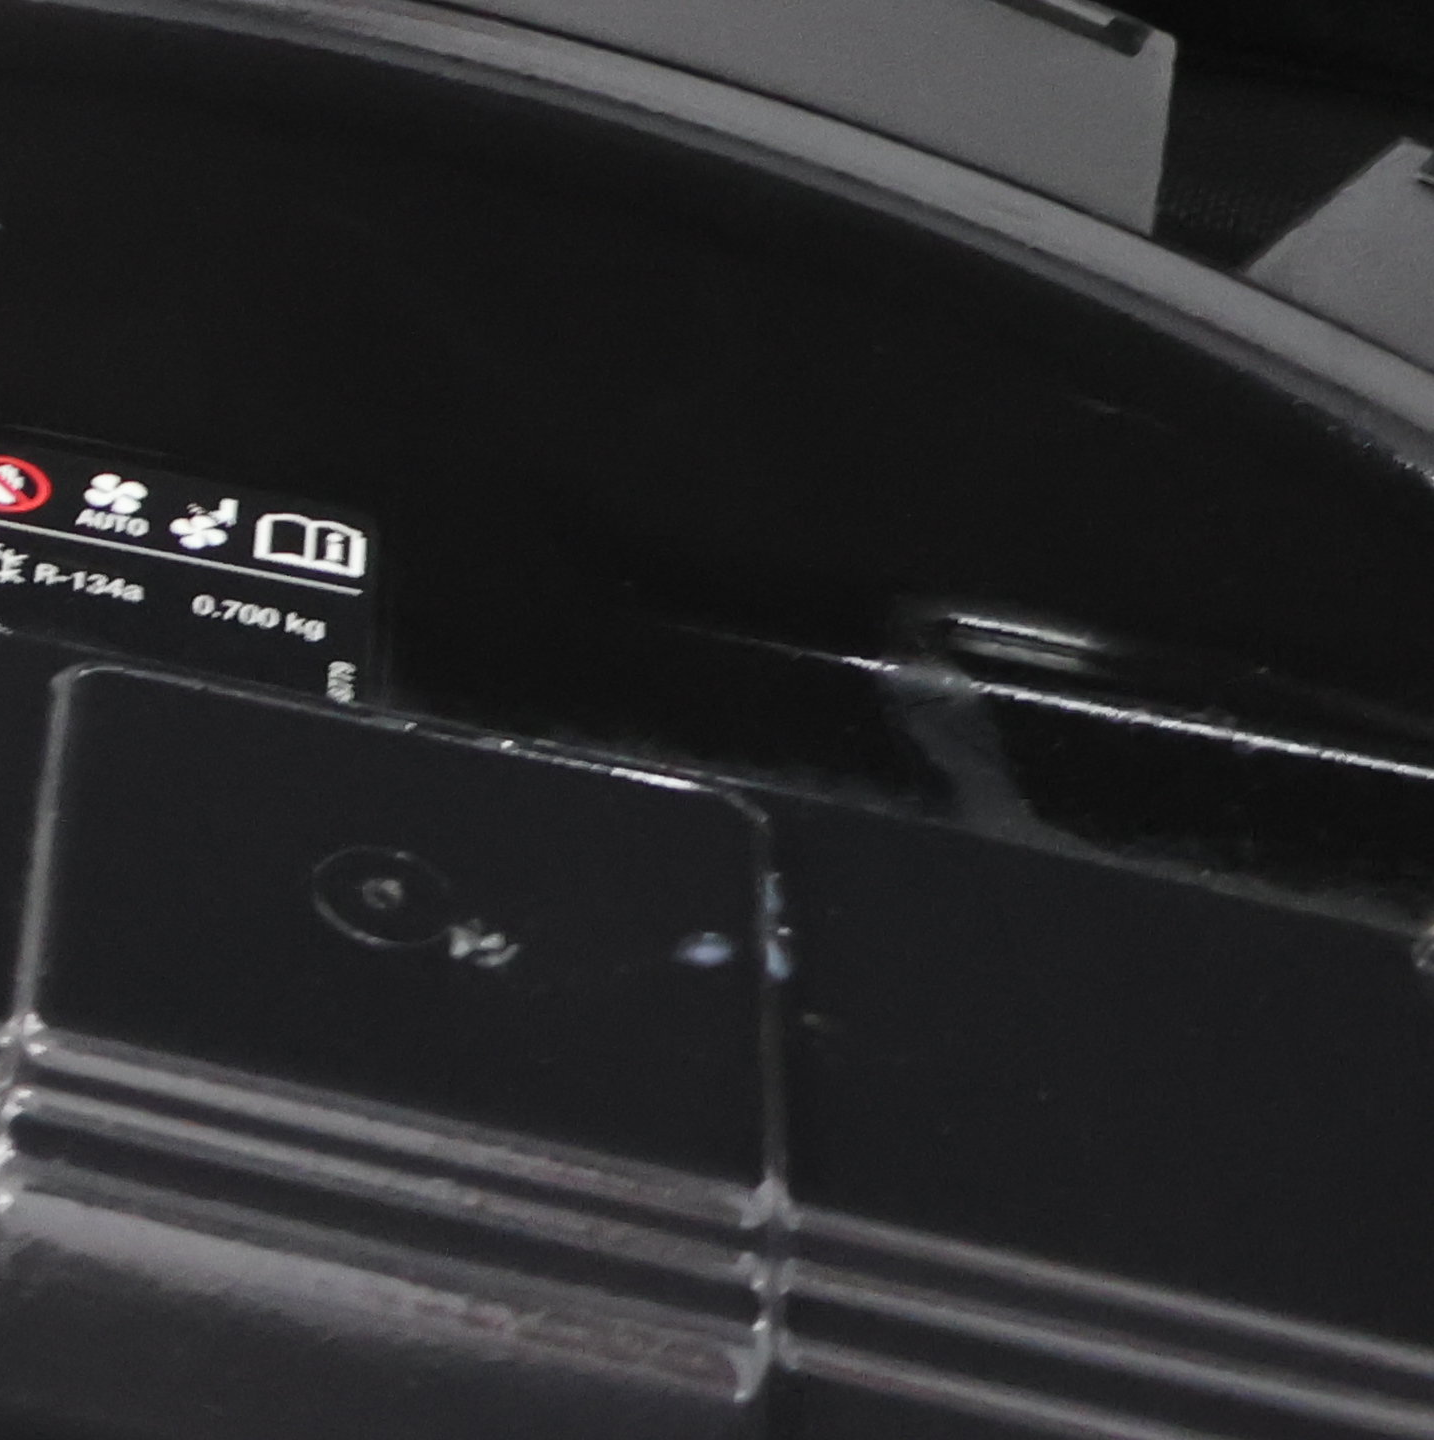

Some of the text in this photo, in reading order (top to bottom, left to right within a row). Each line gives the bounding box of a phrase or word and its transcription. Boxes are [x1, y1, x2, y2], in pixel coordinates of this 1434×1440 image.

[74, 508, 149, 537] AUTO
[33, 562, 145, 603] R-134a
[191, 594, 327, 643] 0.700 kg
